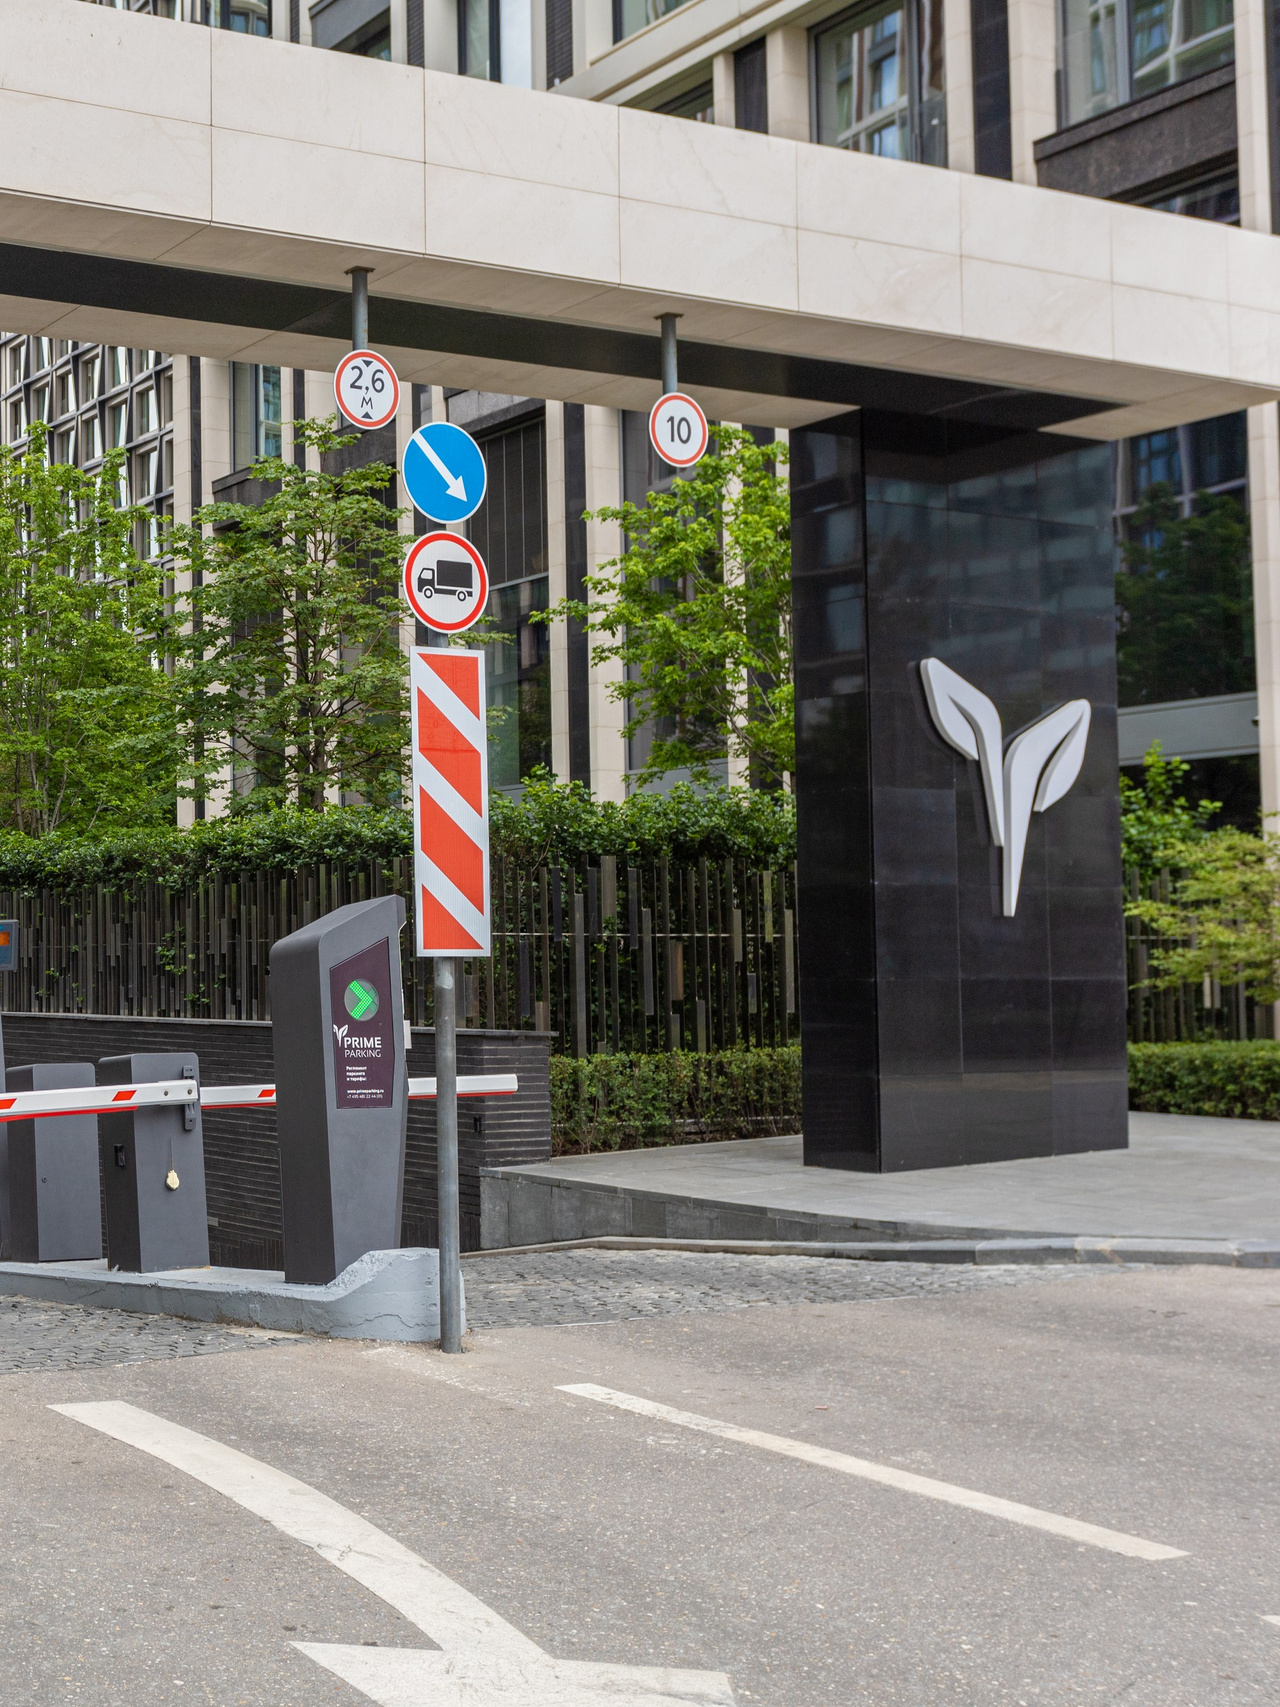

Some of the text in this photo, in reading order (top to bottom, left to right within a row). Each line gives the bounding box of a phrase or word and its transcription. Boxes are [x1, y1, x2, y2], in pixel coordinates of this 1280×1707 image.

[349, 365, 385, 395] 2,6
[666, 415, 692, 445] 10
[344, 1037, 382, 1048] PRIME
[344, 1049, 381, 1058] PARKING
